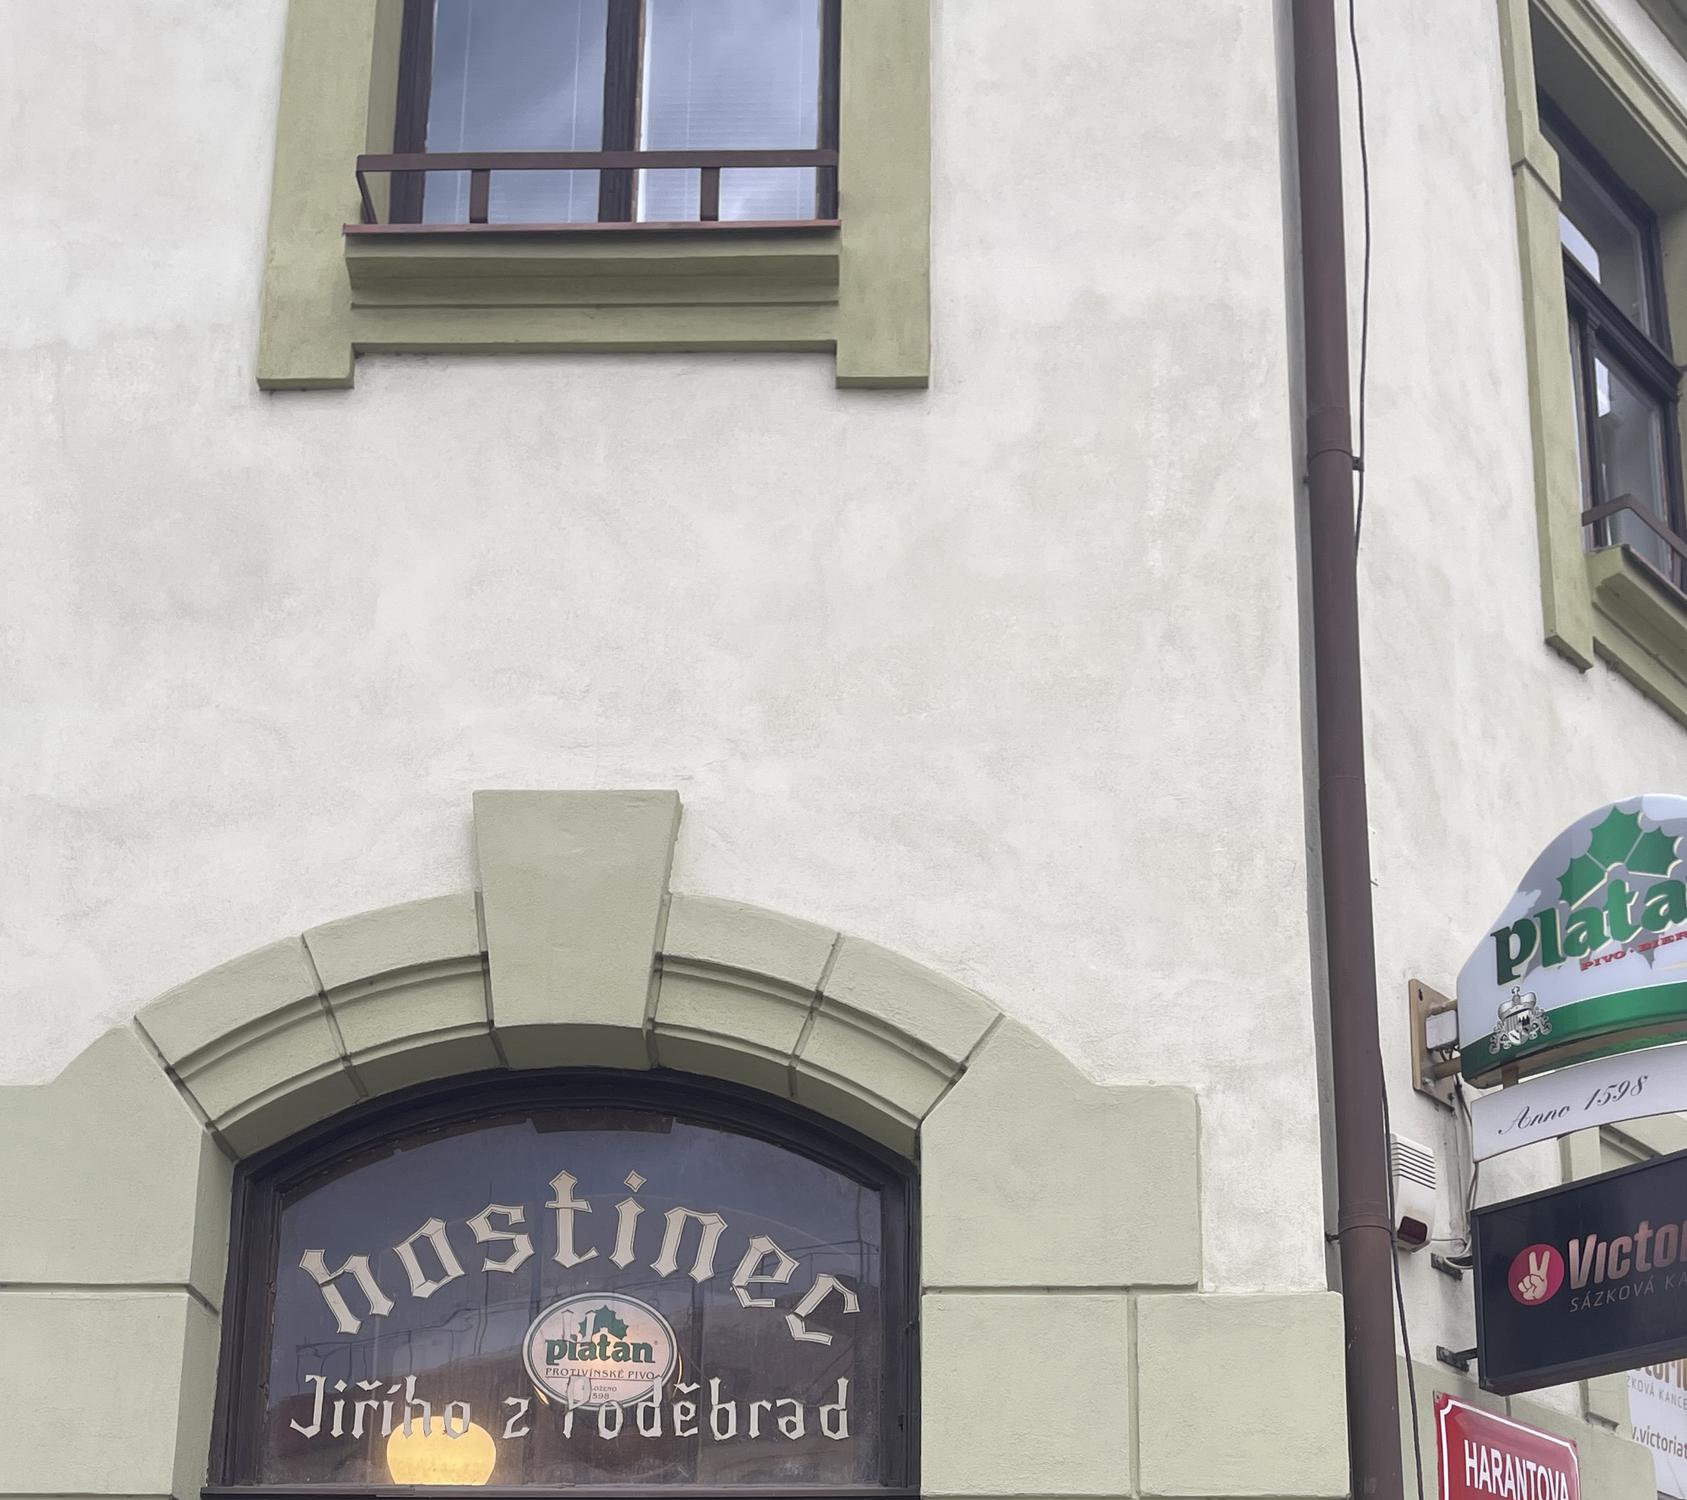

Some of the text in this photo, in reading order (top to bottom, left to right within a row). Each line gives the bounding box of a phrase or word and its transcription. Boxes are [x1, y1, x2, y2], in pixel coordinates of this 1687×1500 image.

[1580, 949, 1627, 971] PIVO
[1498, 1074, 1648, 1135] Anno 1598
[299, 1170, 860, 1345] hostinec
[1569, 1275, 1655, 1313] SÁZKOVÁ
[545, 1366, 655, 1380] PROTIVÍNSKÉ PIVO
[290, 1375, 471, 1440] Jiřího
[563, 1374, 851, 1441] Poděbrad
